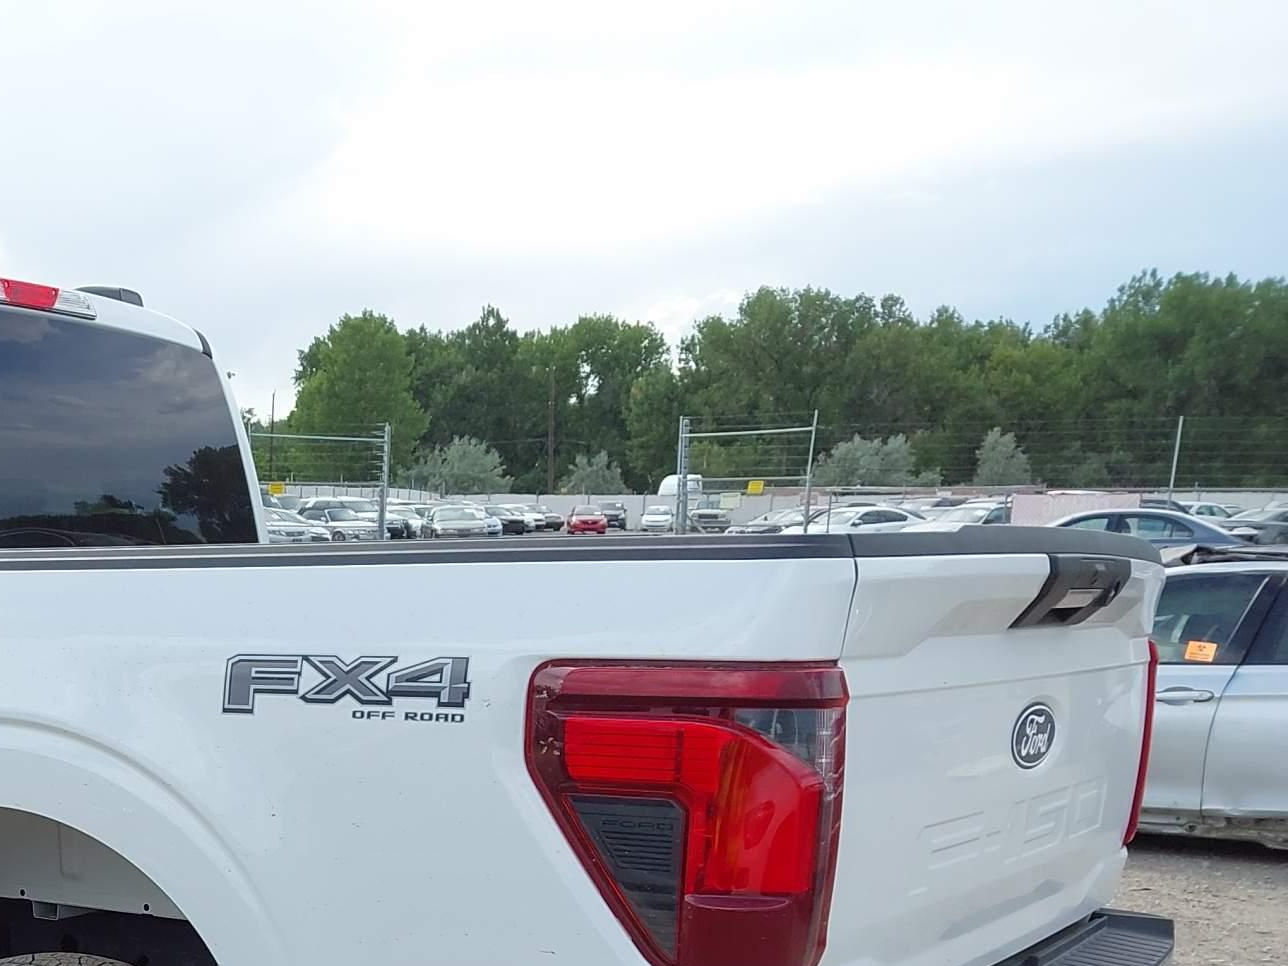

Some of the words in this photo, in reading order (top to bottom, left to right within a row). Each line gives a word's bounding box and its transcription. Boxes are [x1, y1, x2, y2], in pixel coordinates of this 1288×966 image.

[222, 654, 471, 714] FX4
[352, 710, 396, 721] OFF
[404, 712, 465, 723] ROAD
[1021, 715, 1051, 757] Ford
[601, 819, 674, 831] FORD
